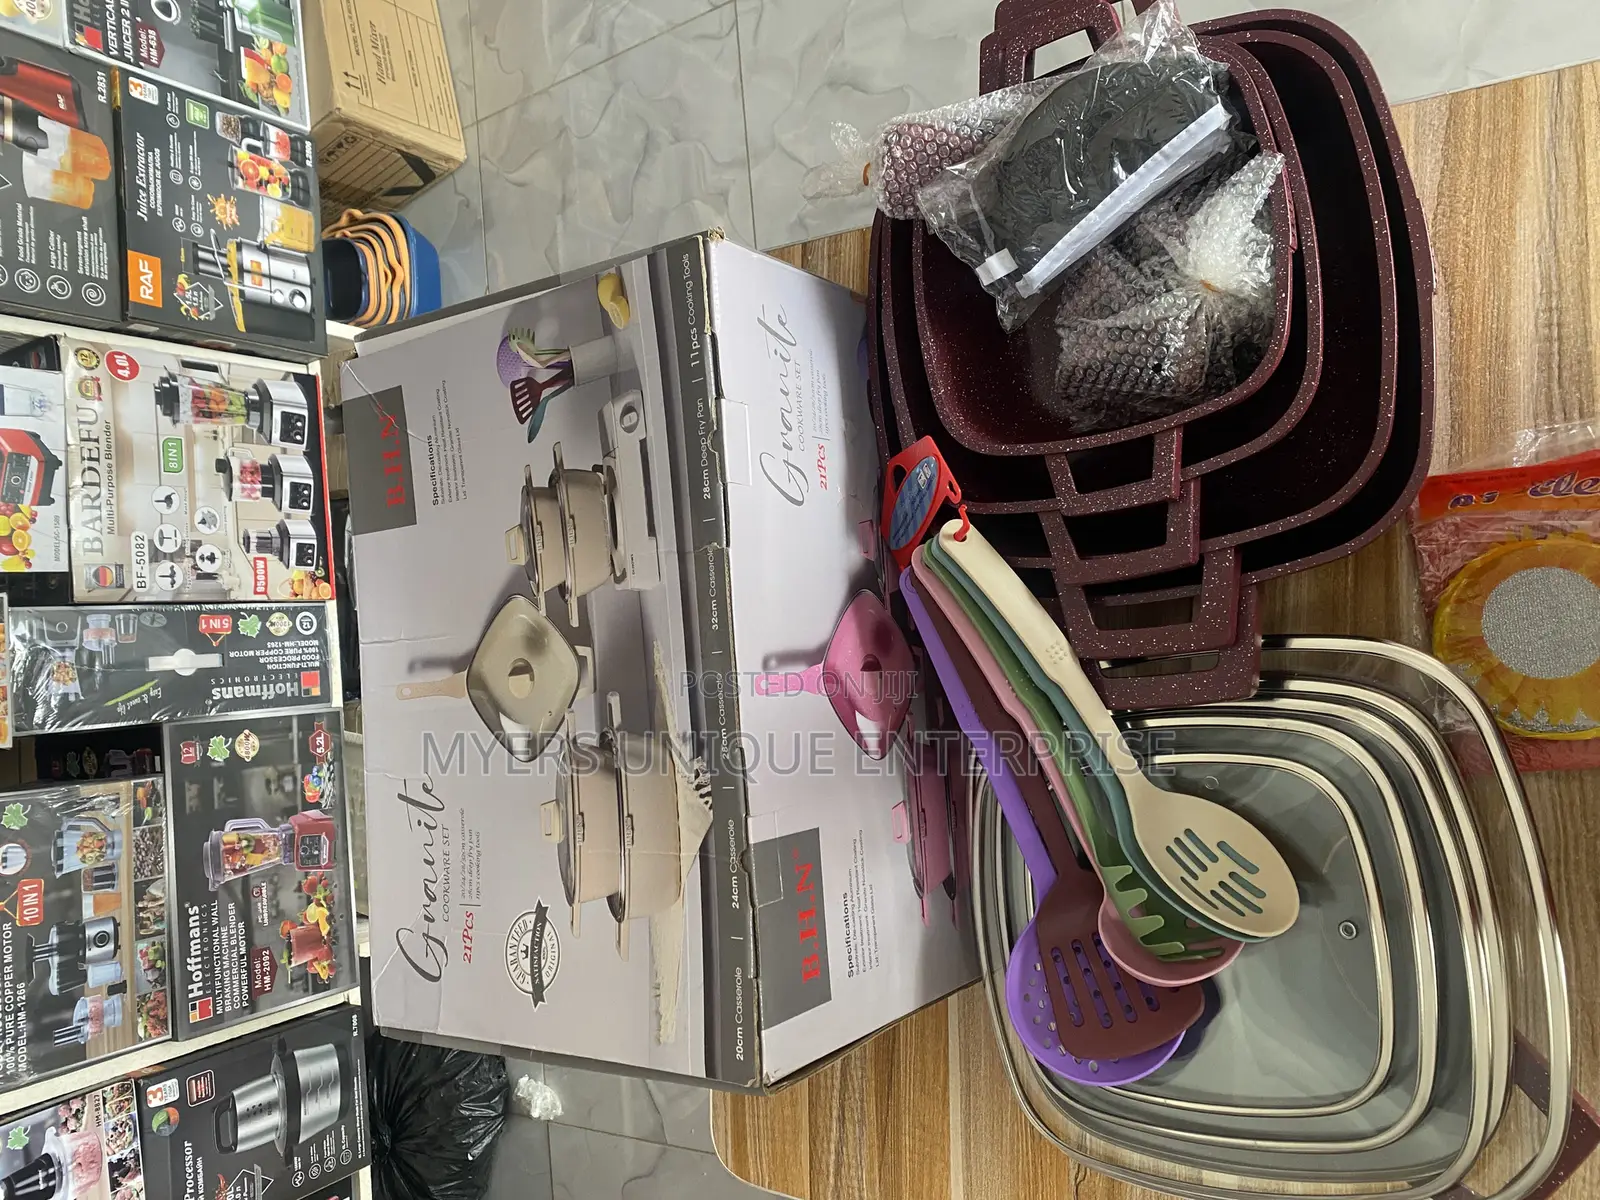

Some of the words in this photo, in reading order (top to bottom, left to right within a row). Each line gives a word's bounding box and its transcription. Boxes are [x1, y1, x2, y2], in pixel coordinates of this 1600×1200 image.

[120, 8, 131, 18] 2
[121, 20, 134, 62] JUICER
[138, 28, 148, 58] Model:
[148, 30, 158, 64] HM-638
[370, 20, 381, 52] Mixer
[373, 52, 387, 86] Hand
[96, 70, 107, 104] R.2831
[135, 132, 146, 188] Extractor
[155, 170, 161, 178] DE
[136, 186, 148, 221] Juice
[138, 258, 154, 300] RAF
[681, 254, 691, 279] Tools
[685, 281, 696, 325] Cooking
[80, 353, 88, 362] 12
[689, 328, 700, 367] 11pcs
[114, 354, 130, 378] 4.0L
[794, 360, 802, 380] SET
[695, 398, 704, 418] Pan
[756, 304, 810, 506] Granite
[795, 384, 805, 452] COOKWARE
[103, 420, 113, 460] Blender
[697, 419, 707, 435] Fry
[379, 414, 406, 508] B.H.N
[700, 438, 710, 466] Deep
[76, 404, 104, 556] BARDEFU
[426, 434, 440, 506] Specifications
[702, 469, 711, 500] 28cm
[105, 463, 116, 535] Multi-Purpose
[134, 534, 147, 589] BF-5082
[256, 559, 266, 592] 9500W
[707, 547, 717, 597] Casserole
[201, 620, 206, 631] 1
[210, 618, 220, 630] IN
[223, 618, 229, 628] 5
[710, 600, 719, 630] 32cm
[229, 650, 254, 658] MOTOR
[259, 654, 300, 664] PROCESSOR
[267, 660, 320, 670] MULTI-FUNCTION
[211, 682, 298, 700] Hoffmans
[316, 733, 325, 754] 5.2L
[720, 728, 729, 760] 28cm
[441, 824, 450, 847] SET
[726, 819, 738, 874] Casserole
[396, 772, 448, 982] Granite
[442, 850, 450, 922] COOKWARE
[731, 876, 740, 909] 24cm
[23, 892, 39, 905] IN
[23, 908, 39, 921] 10
[210, 900, 218, 924] WALL
[228, 902, 236, 944] BLENDER
[238, 922, 246, 954] MOTOR
[794, 863, 821, 984] B.H.N
[842, 892, 854, 978] Specifications
[2, 922, 12, 962] MOTOR
[186, 906, 203, 998] Hoffmans
[202, 904, 212, 993] ELECTRONICS
[221, 926, 230, 968] MACHINE
[508, 919, 530, 984] GUARANTEED
[532, 922, 542, 985] SATISFACTION
[544, 930, 556, 978] ORIGINAL
[212, 927, 223, 1014] MULTIFUNCTIONAL
[231, 946, 240, 1009] COMMERCIAL
[240, 956, 249, 1006] POWERFUL
[254, 958, 262, 988] Model:
[262, 950, 272, 991] HM-2092
[4, 964, 14, 1012] COPPER
[224, 970, 232, 1012] BRAKING
[734, 967, 744, 1024] Casserole
[5, 1014, 14, 1043] PURE
[16, 982, 27, 1072] MODEL:HM-1266
[736, 1027, 744, 1060] 20cm
[6, 1047, 16, 1074] 100%
[94, 1094, 102, 1127] HM-8827
